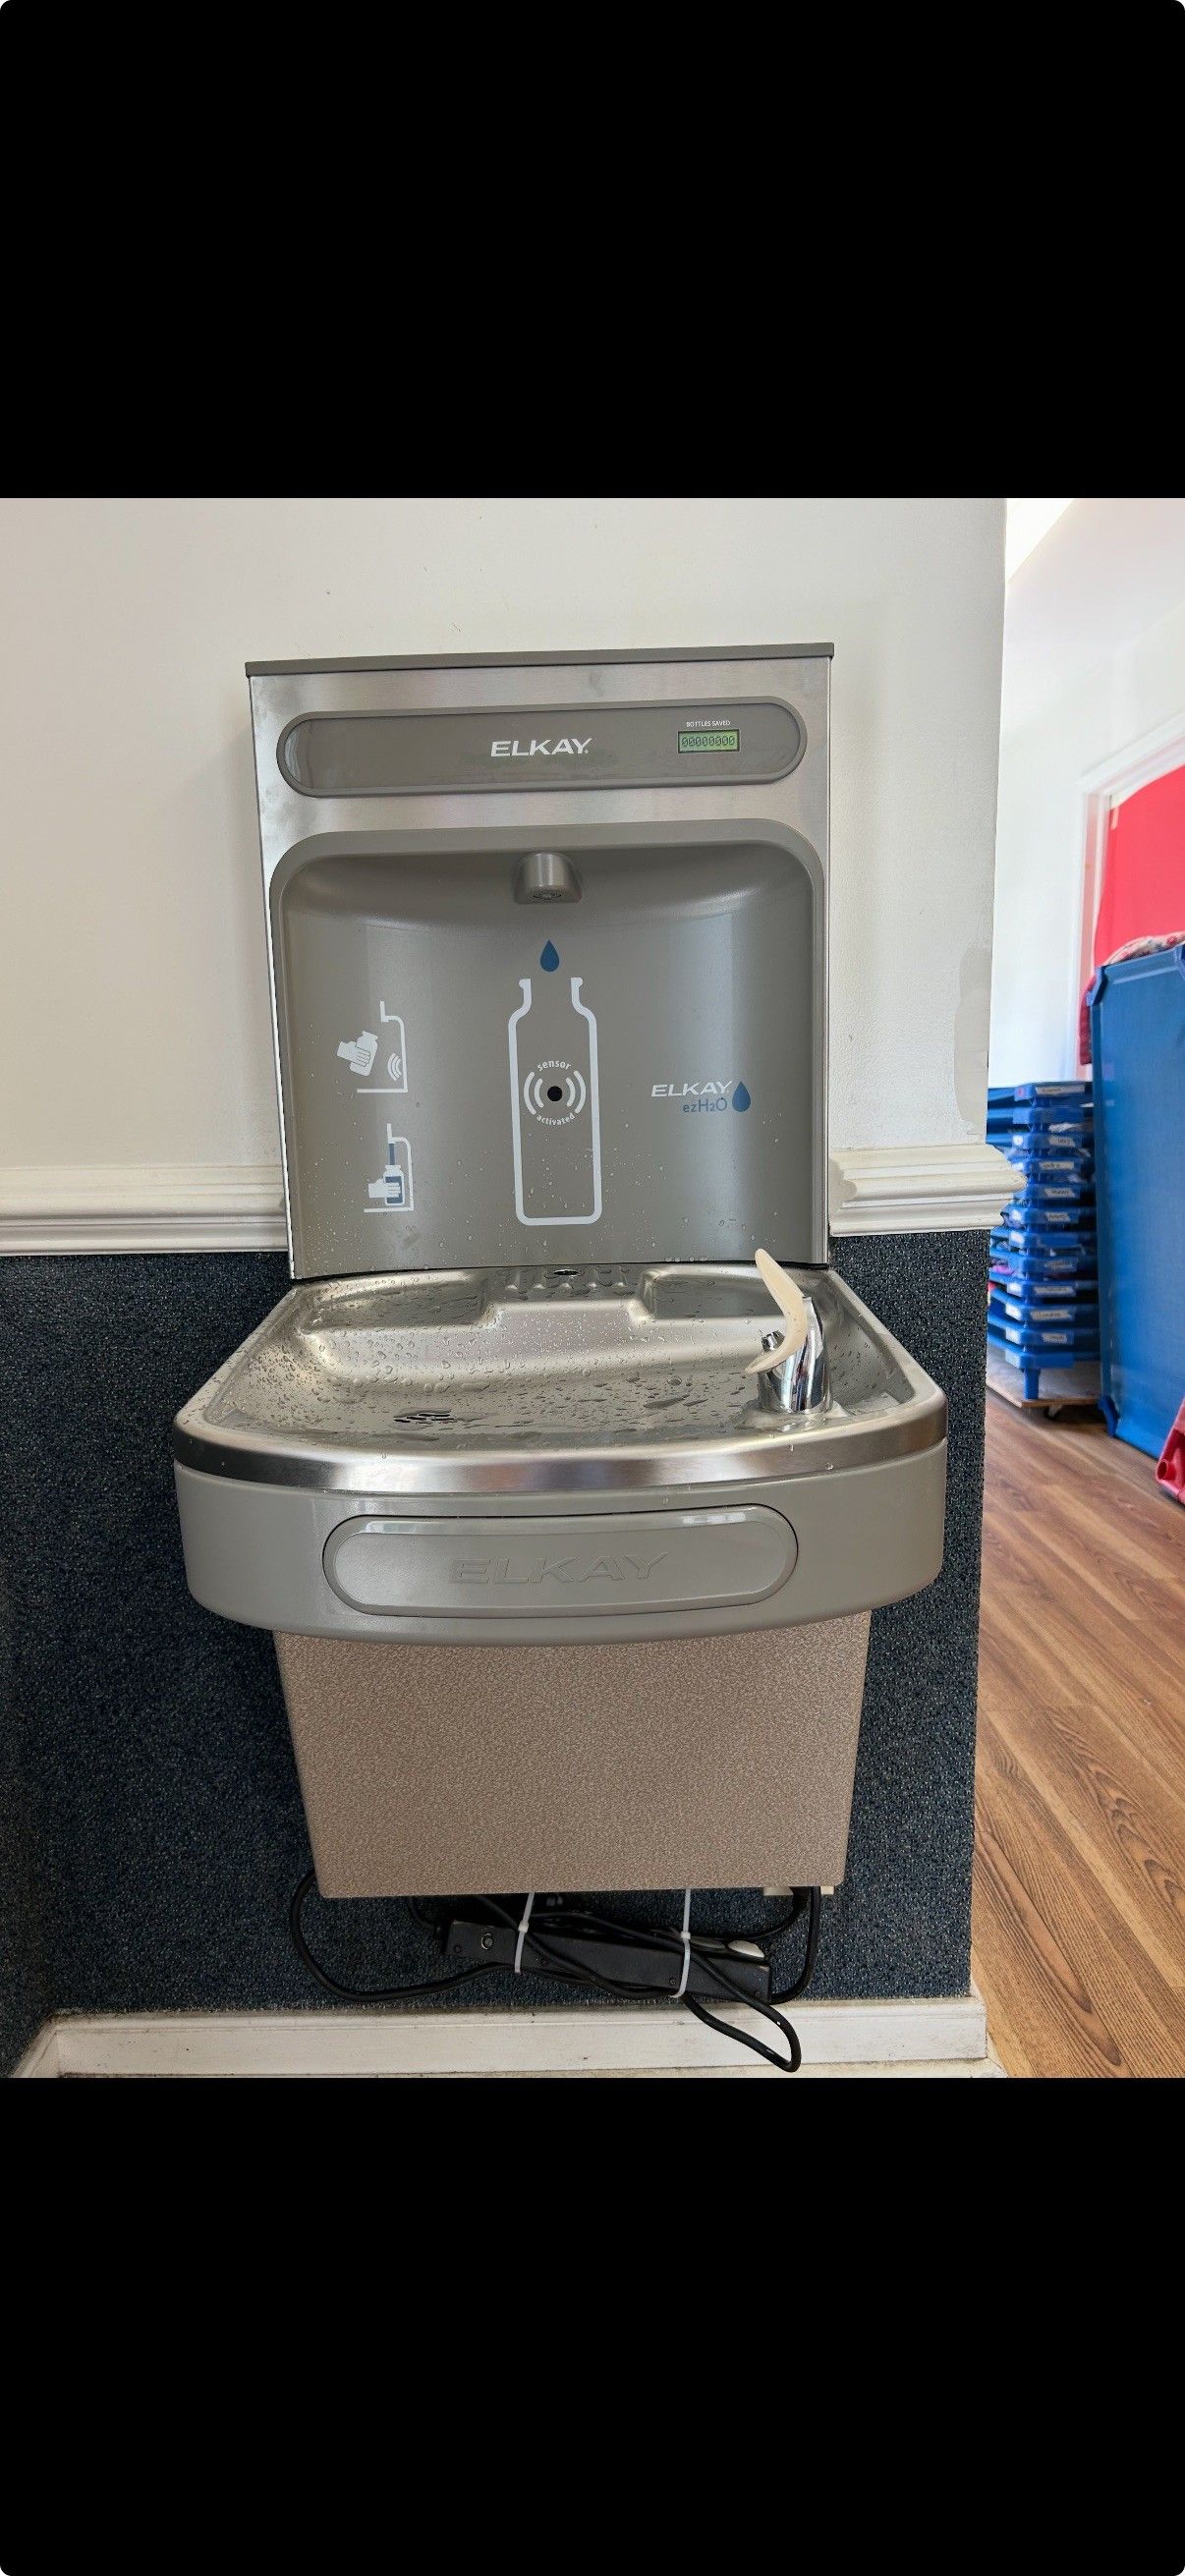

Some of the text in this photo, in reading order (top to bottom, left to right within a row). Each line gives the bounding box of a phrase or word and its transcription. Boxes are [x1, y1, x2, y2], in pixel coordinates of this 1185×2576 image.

[536, 1060, 572, 1072] sensor
[536, 1112, 576, 1126] activated
[448, 1549, 670, 1584] ELKAY
